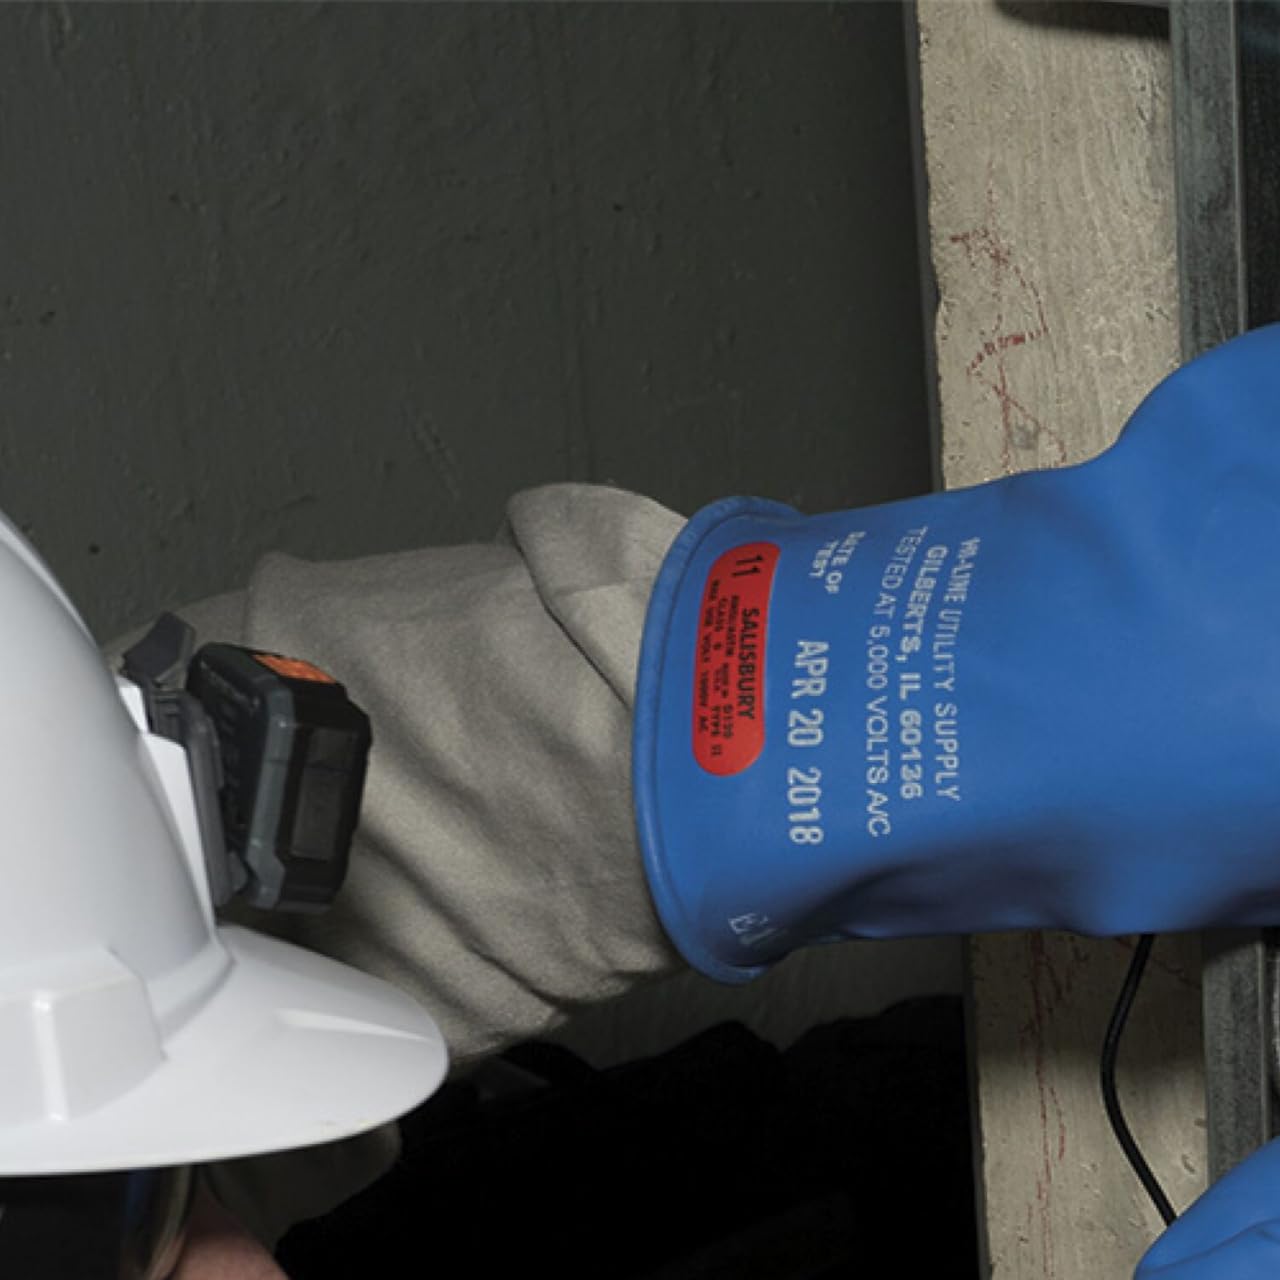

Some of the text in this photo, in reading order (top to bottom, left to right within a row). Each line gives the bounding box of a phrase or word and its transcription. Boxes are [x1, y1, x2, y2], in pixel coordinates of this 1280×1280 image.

[732, 552, 765, 578] 11
[879, 525, 928, 590] TESTED
[872, 592, 897, 620] AT
[737, 606, 761, 721] SALISBURY
[894, 544, 947, 801] GILBERTS, IL 60136
[933, 608, 962, 692] UTILITY
[787, 640, 830, 845] APR 20 2018
[866, 695, 888, 785] VOLTS
[934, 702, 960, 802] SUPPLY
[865, 788, 891, 838] A/C
